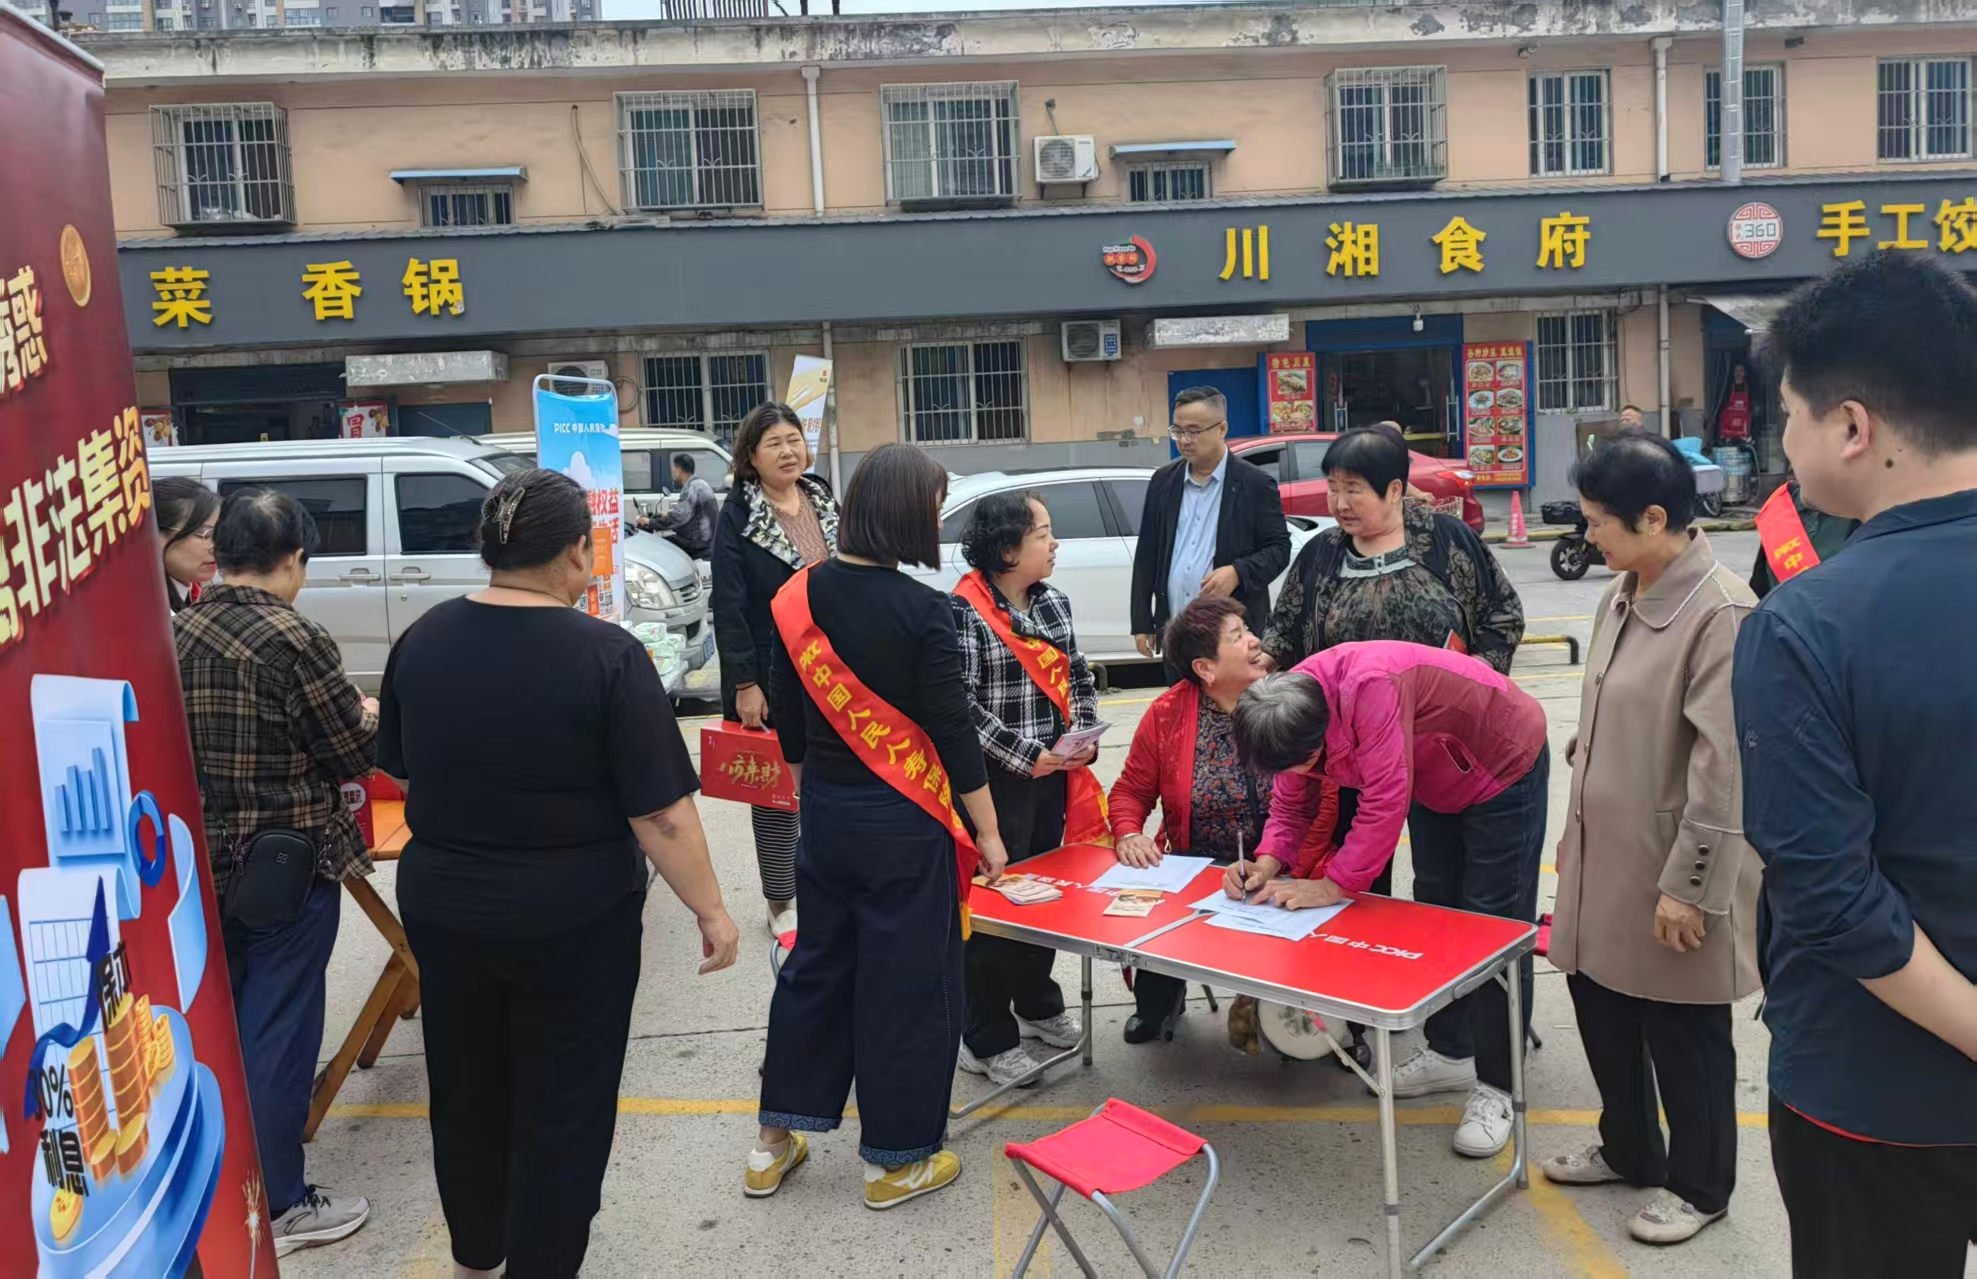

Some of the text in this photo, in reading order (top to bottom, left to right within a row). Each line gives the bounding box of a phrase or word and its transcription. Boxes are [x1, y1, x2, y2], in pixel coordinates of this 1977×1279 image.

[1219, 211, 1591, 280] 川湘食府
[1743, 222, 1776, 238] 360
[554, 422, 570, 433] PICC
[39, 1128, 90, 1197] 利息
